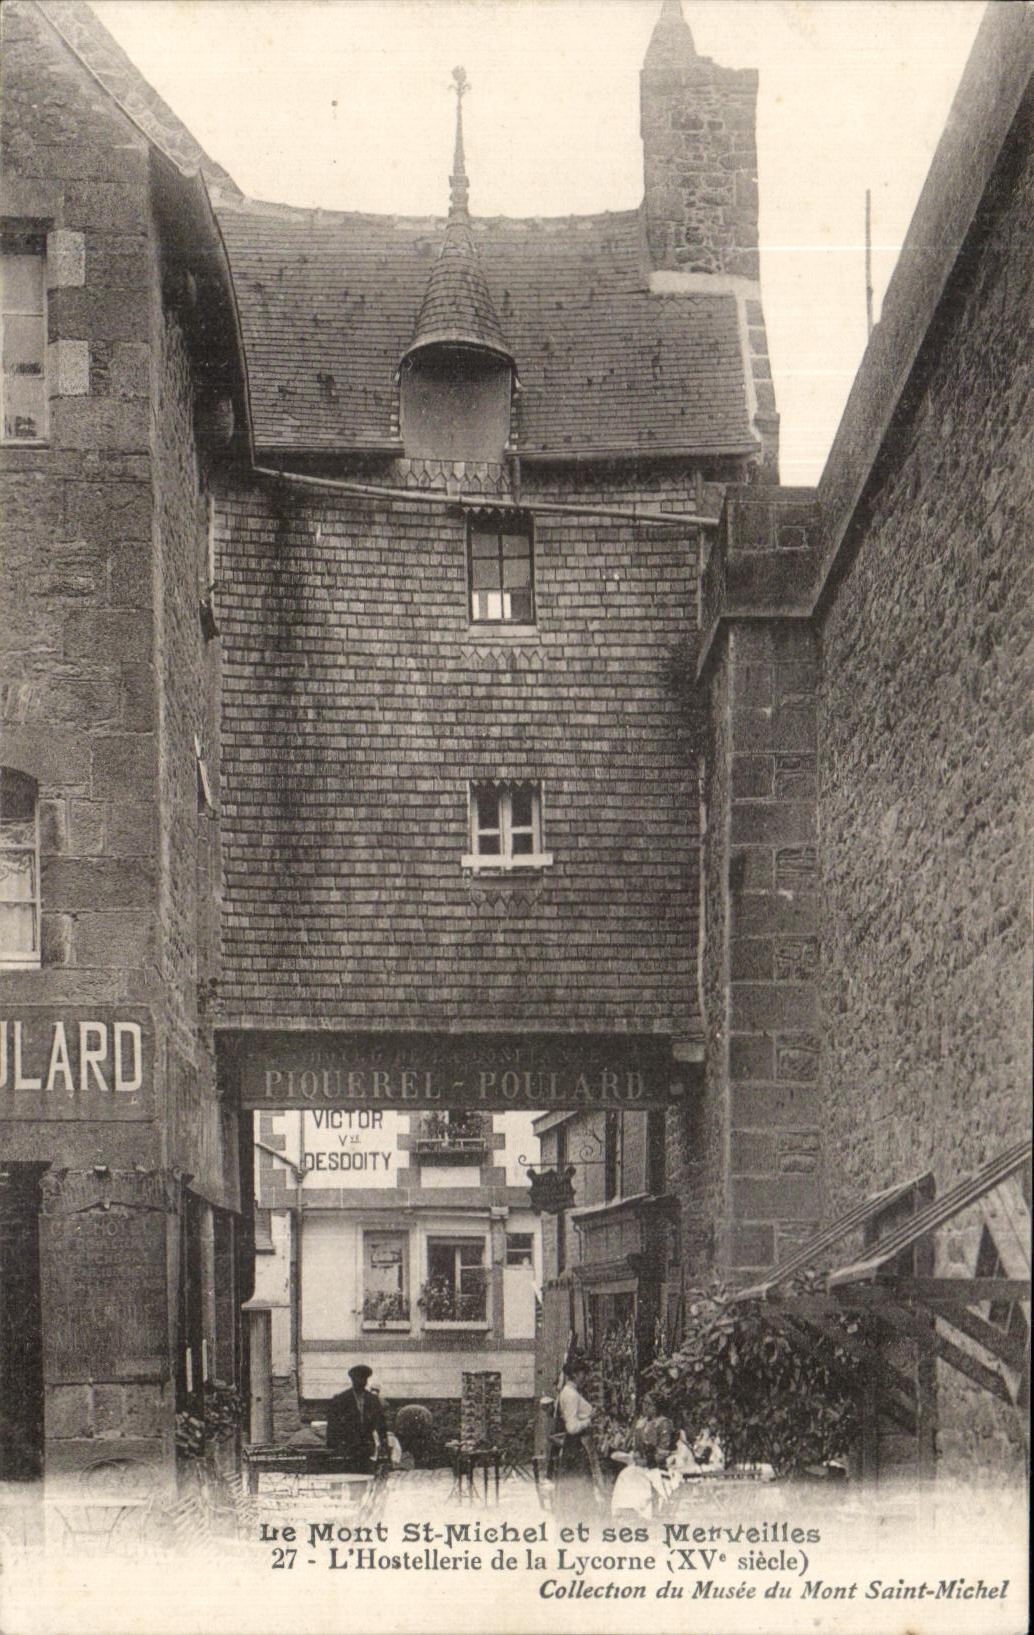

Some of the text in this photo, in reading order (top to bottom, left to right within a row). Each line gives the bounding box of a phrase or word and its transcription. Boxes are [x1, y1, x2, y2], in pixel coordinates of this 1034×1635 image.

[0, 1021, 143, 1092] LARD
[265, 1070, 440, 1100] PIQUEREL
[479, 1070, 643, 1100] POULARD
[312, 1109, 383, 1129] VICTOR
[304, 1151, 392, 1171] DESDOITY
